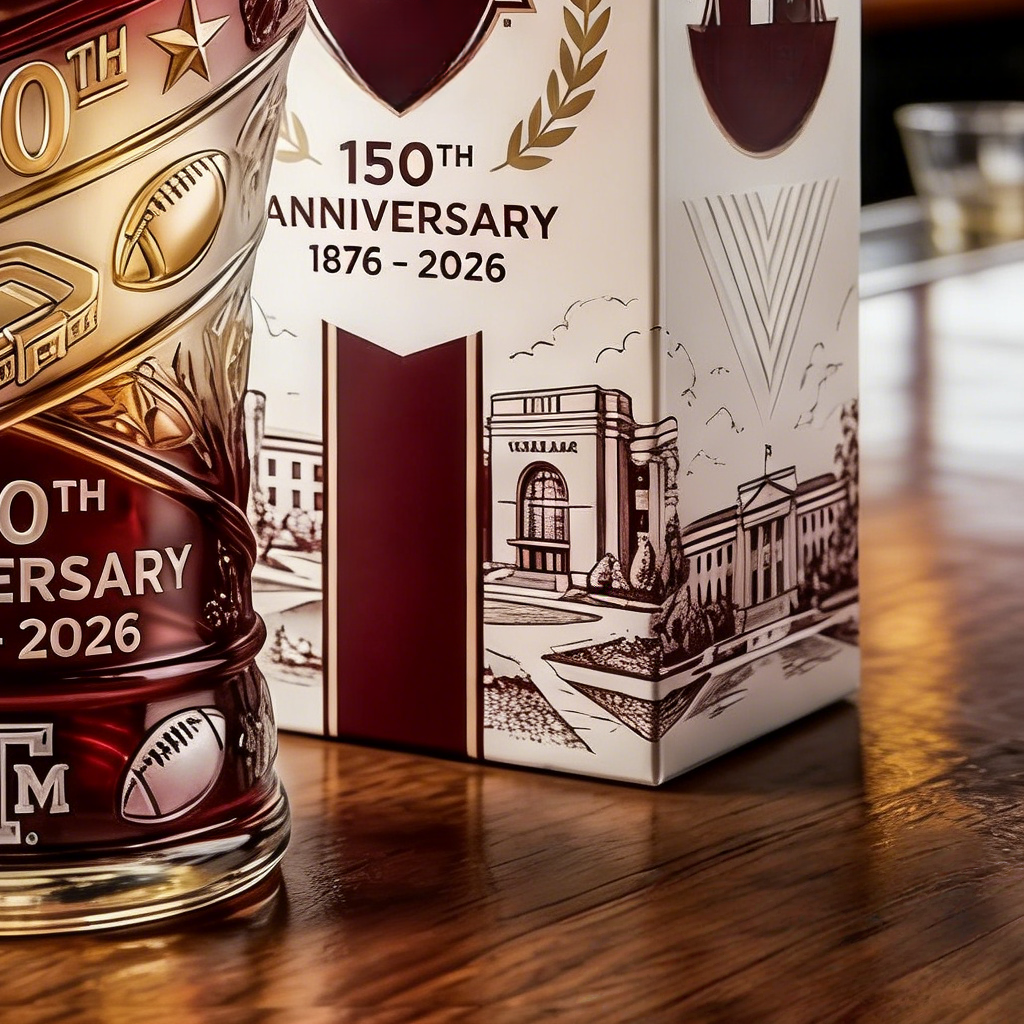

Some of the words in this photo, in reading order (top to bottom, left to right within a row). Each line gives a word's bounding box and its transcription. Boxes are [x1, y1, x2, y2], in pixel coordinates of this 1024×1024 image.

[339, 140, 474, 188] 150TH
[267, 194, 559, 240] ANNIVERSARY
[308, 244, 382, 276] 1876
[418, 249, 506, 283] 2026
[18, 612, 141, 660] 2026
